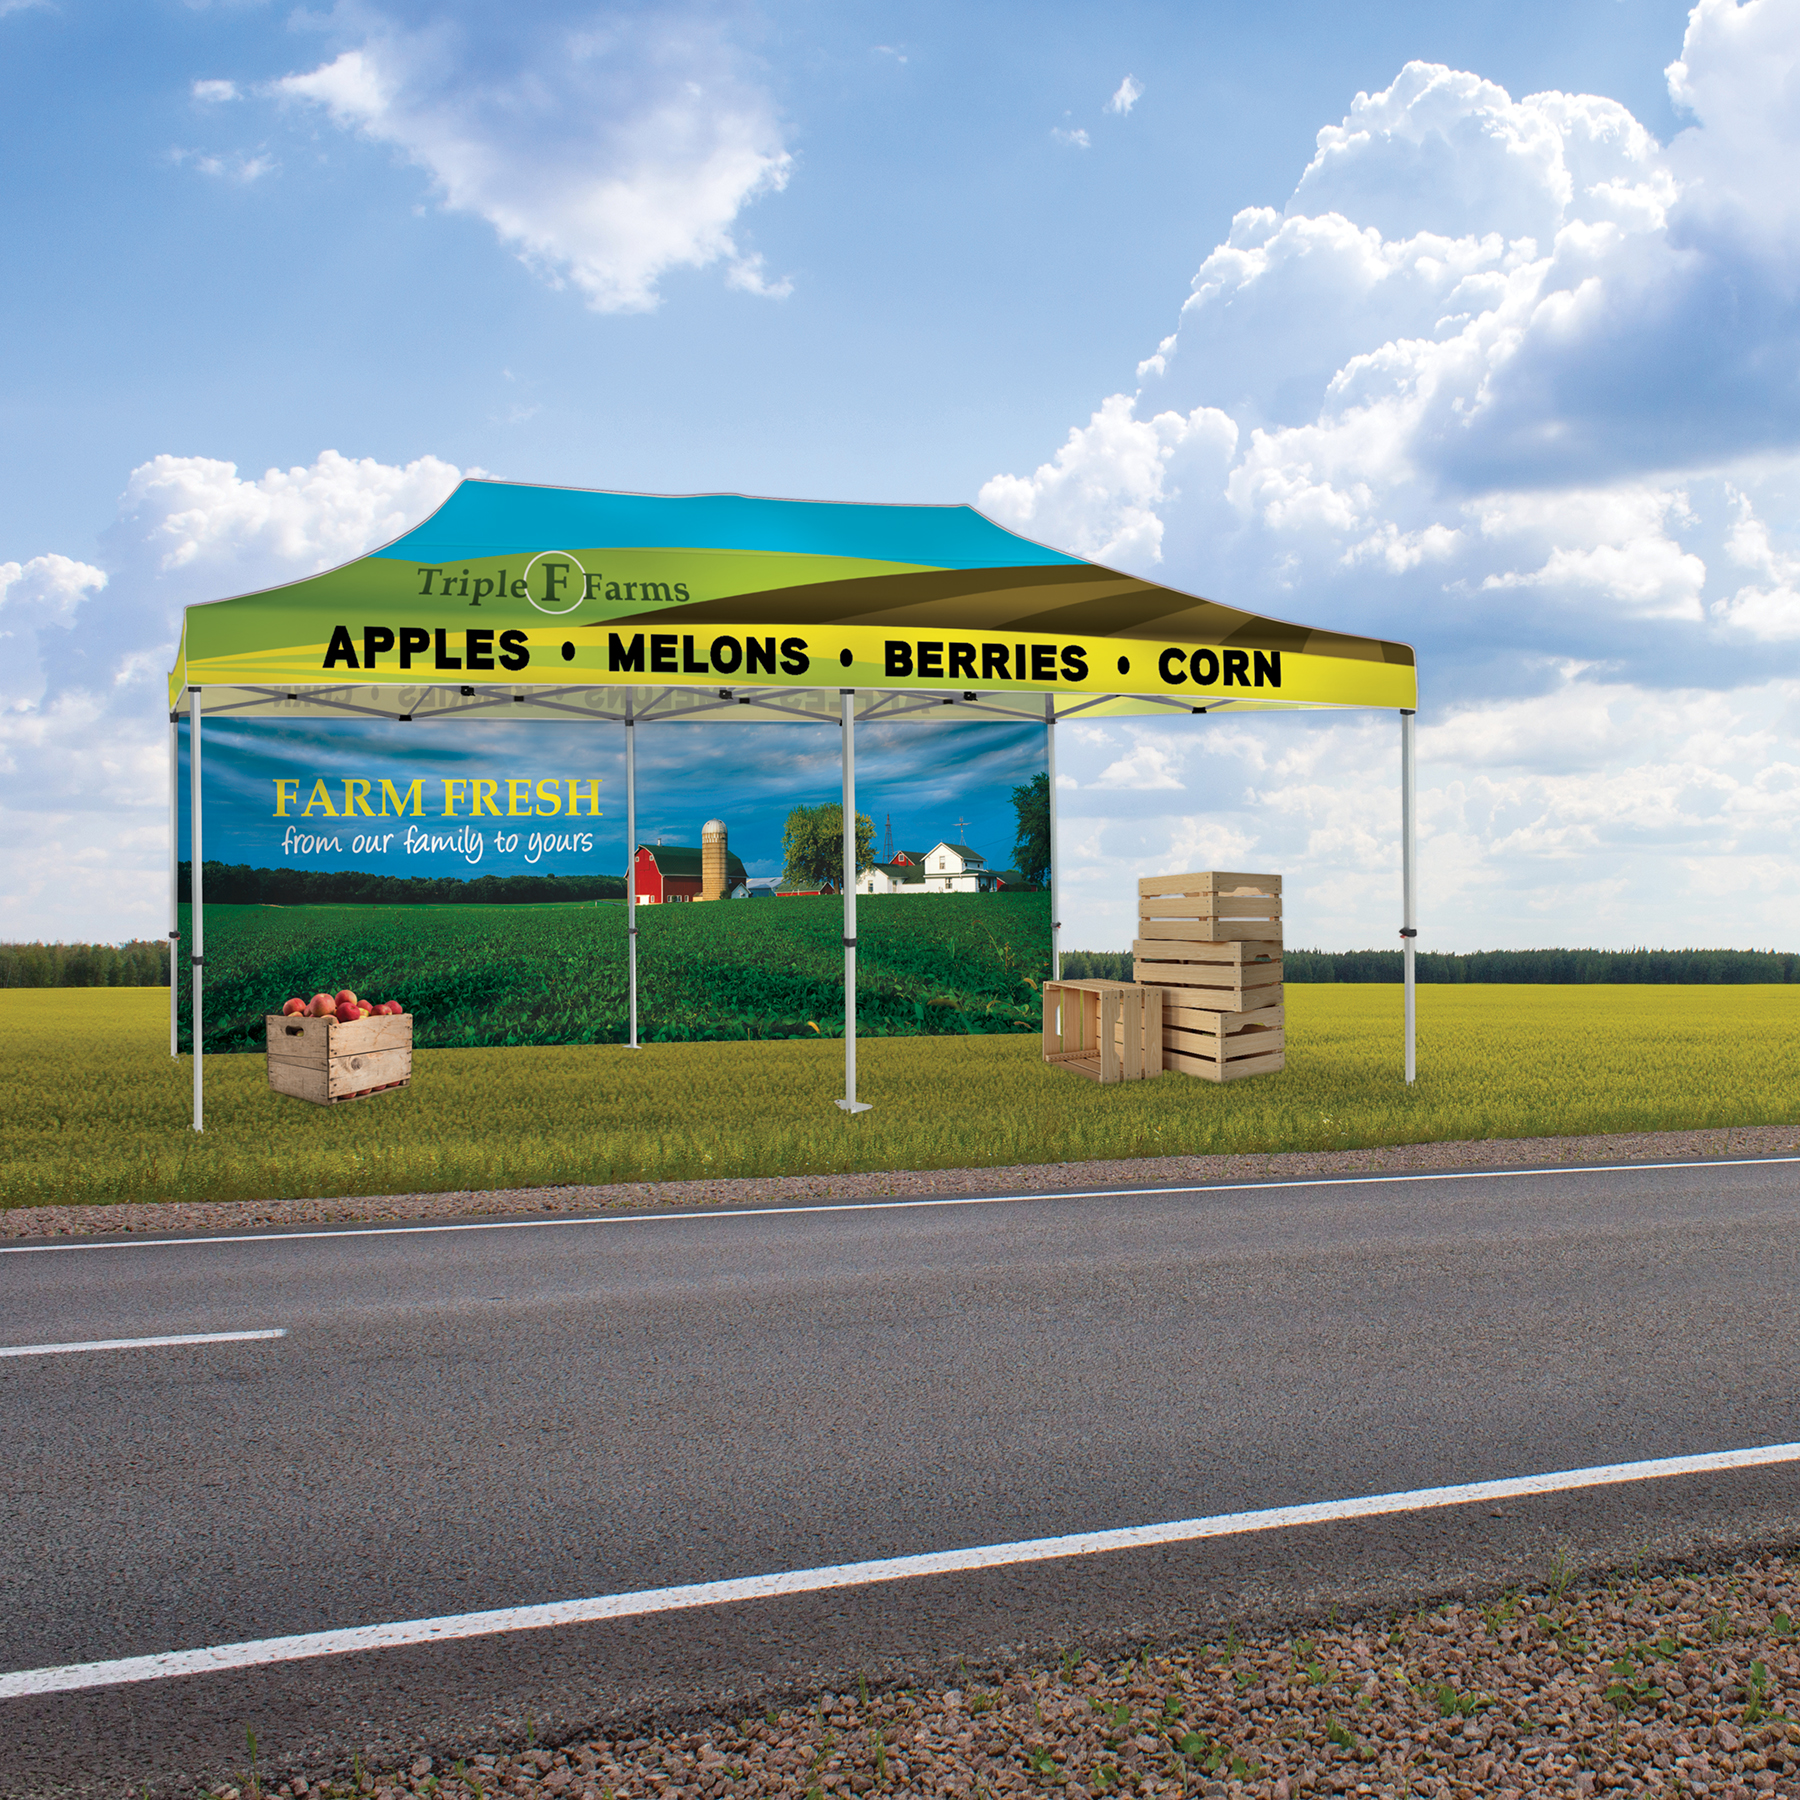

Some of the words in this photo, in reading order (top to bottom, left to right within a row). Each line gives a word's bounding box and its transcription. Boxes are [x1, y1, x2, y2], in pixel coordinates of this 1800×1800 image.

[417, 568, 528, 607] Triple
[541, 563, 570, 602] F
[583, 573, 690, 602] Farms
[323, 626, 530, 671] APPLES
[609, 633, 810, 676] MELONS
[885, 641, 1088, 681] BERRIES
[1159, 648, 1281, 688] CORN
[272, 778, 427, 817] FARM
[440, 778, 604, 817] FRESH
[281, 825, 343, 855] from
[352, 833, 394, 854] our
[403, 825, 483, 864] family
[494, 830, 518, 853] to
[525, 832, 593, 864] yours
